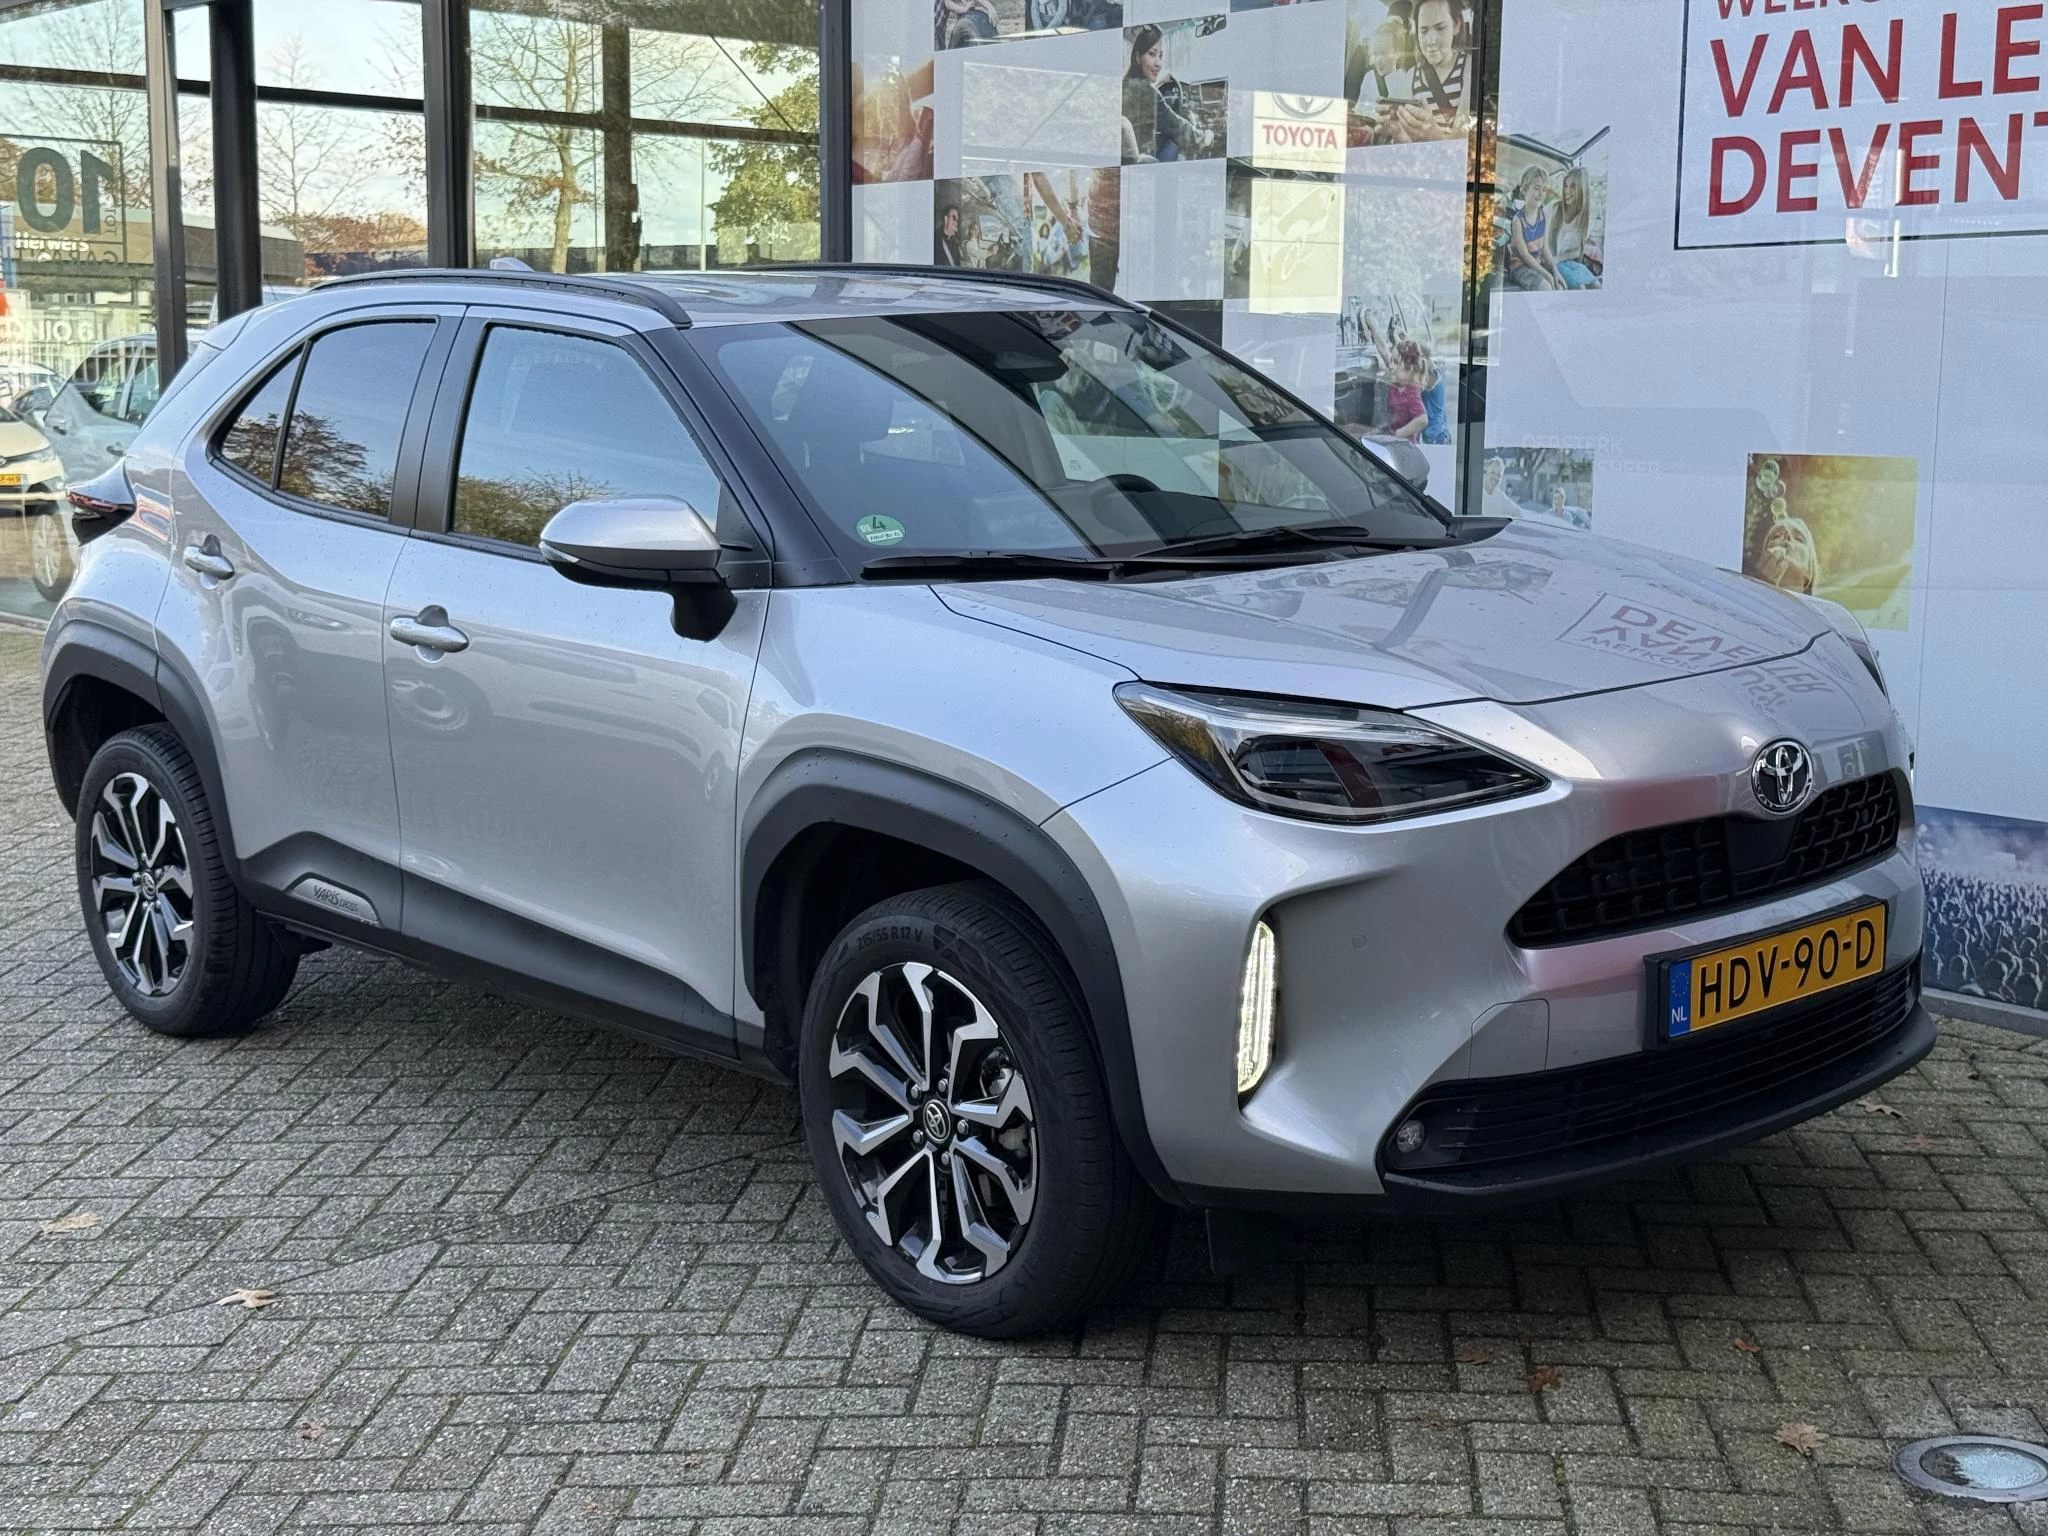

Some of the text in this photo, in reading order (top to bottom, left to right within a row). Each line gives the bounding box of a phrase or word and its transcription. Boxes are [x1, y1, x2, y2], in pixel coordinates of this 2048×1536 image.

[1710, 4, 2044, 118] VAN LE
[1262, 124, 1338, 149] TOYOTA
[1708, 112, 2048, 217] DEVEN
[872, 516, 887, 530] 4
[1700, 919, 1876, 1018] HDV-90-D
[1671, 1007, 1688, 1025] NL
